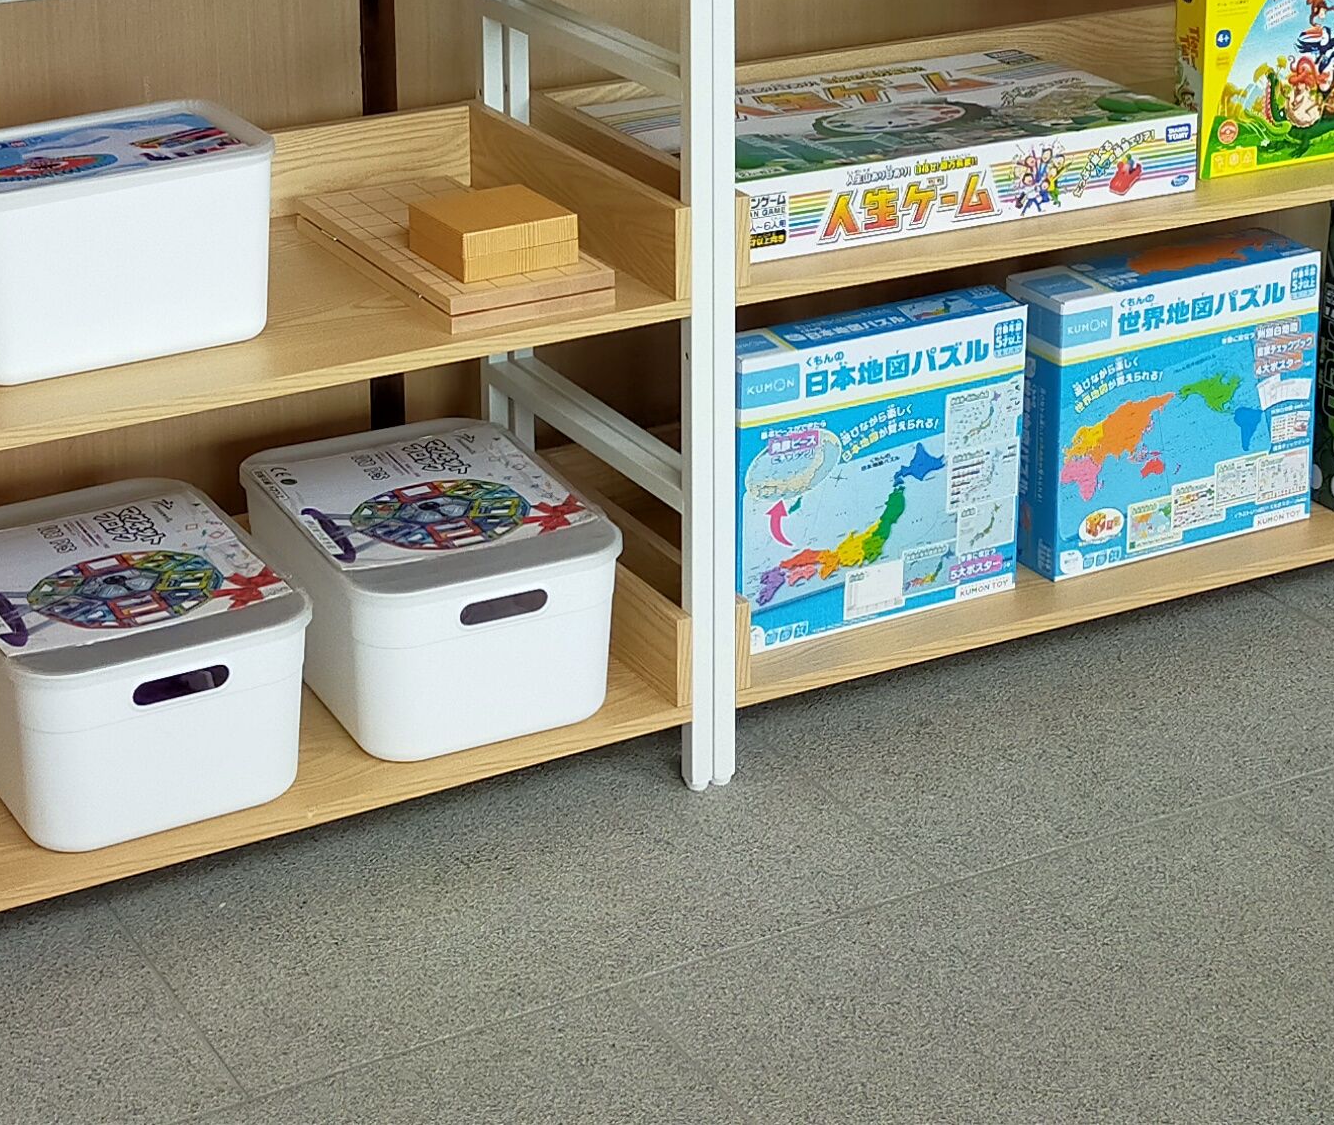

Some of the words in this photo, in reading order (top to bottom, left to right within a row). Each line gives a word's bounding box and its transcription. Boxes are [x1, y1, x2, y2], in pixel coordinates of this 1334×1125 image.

[1217, 34, 1230, 43] 4+
[1168, 132, 1189, 141] TOMY
[822, 172, 995, 240] 人生ゲーム
[1118, 282, 1286, 337] 世界地図パズル
[1120, 294, 1155, 308] くもんの
[1067, 318, 1108, 336] KUMON
[806, 339, 989, 398] 日本地図パズル
[747, 377, 795, 395] KUMON
[1257, 512, 1288, 526] KUMON
[1288, 508, 1302, 520] TOY
[951, 560, 1001, 579] 5大ポスター
[960, 584, 990, 596] KUMON
[992, 579, 1009, 589] TOY
